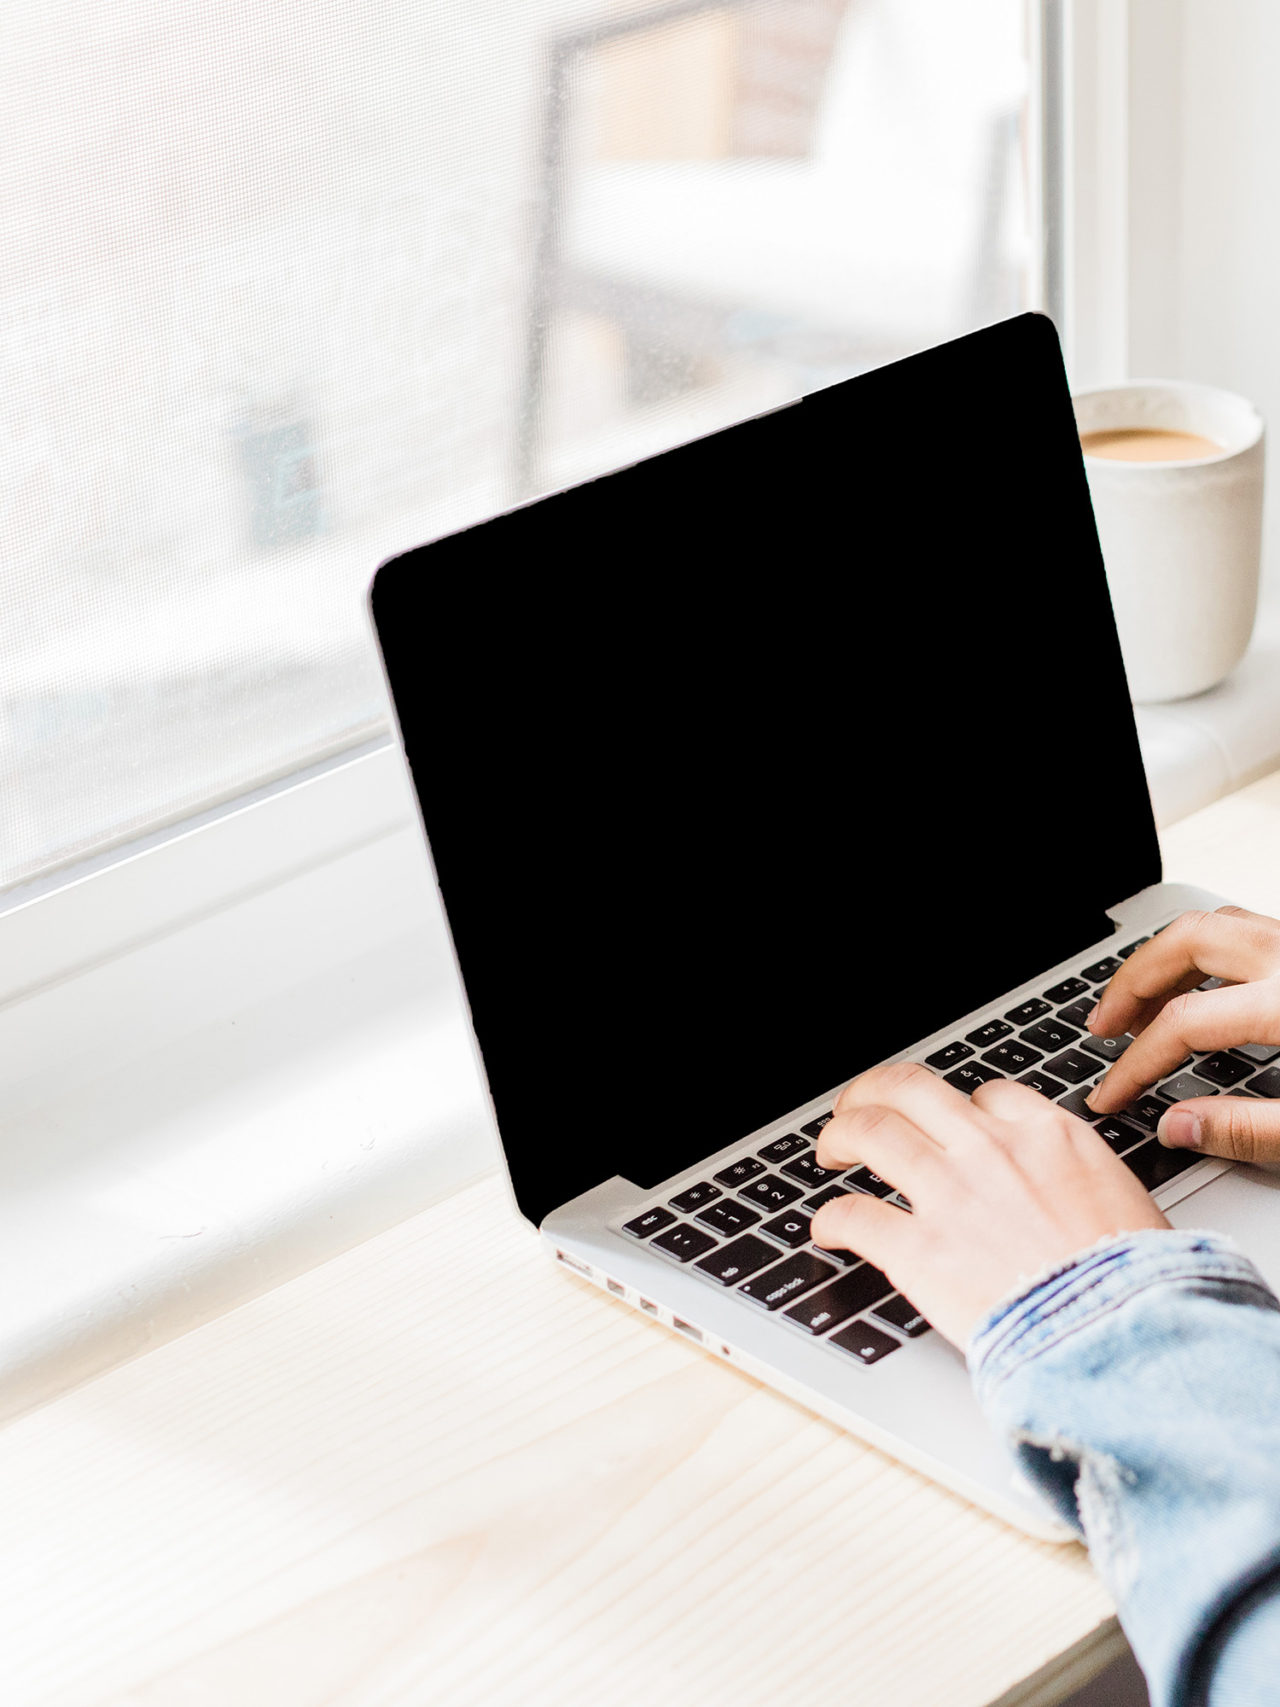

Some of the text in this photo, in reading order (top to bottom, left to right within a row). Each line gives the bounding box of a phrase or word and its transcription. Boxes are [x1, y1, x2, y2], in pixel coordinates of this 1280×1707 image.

[1012, 1054, 1025, 1062] 8
[1103, 1129, 1120, 1140] N
[813, 1167, 826, 1176] 3
[771, 1191, 785, 1200] 2
[728, 1215, 740, 1223] 1
[784, 1222, 801, 1232] Q
[721, 1267, 739, 1278] tab
[765, 1278, 805, 1302] caps lock
[810, 1311, 832, 1328] shift
[860, 1346, 876, 1357] fn
